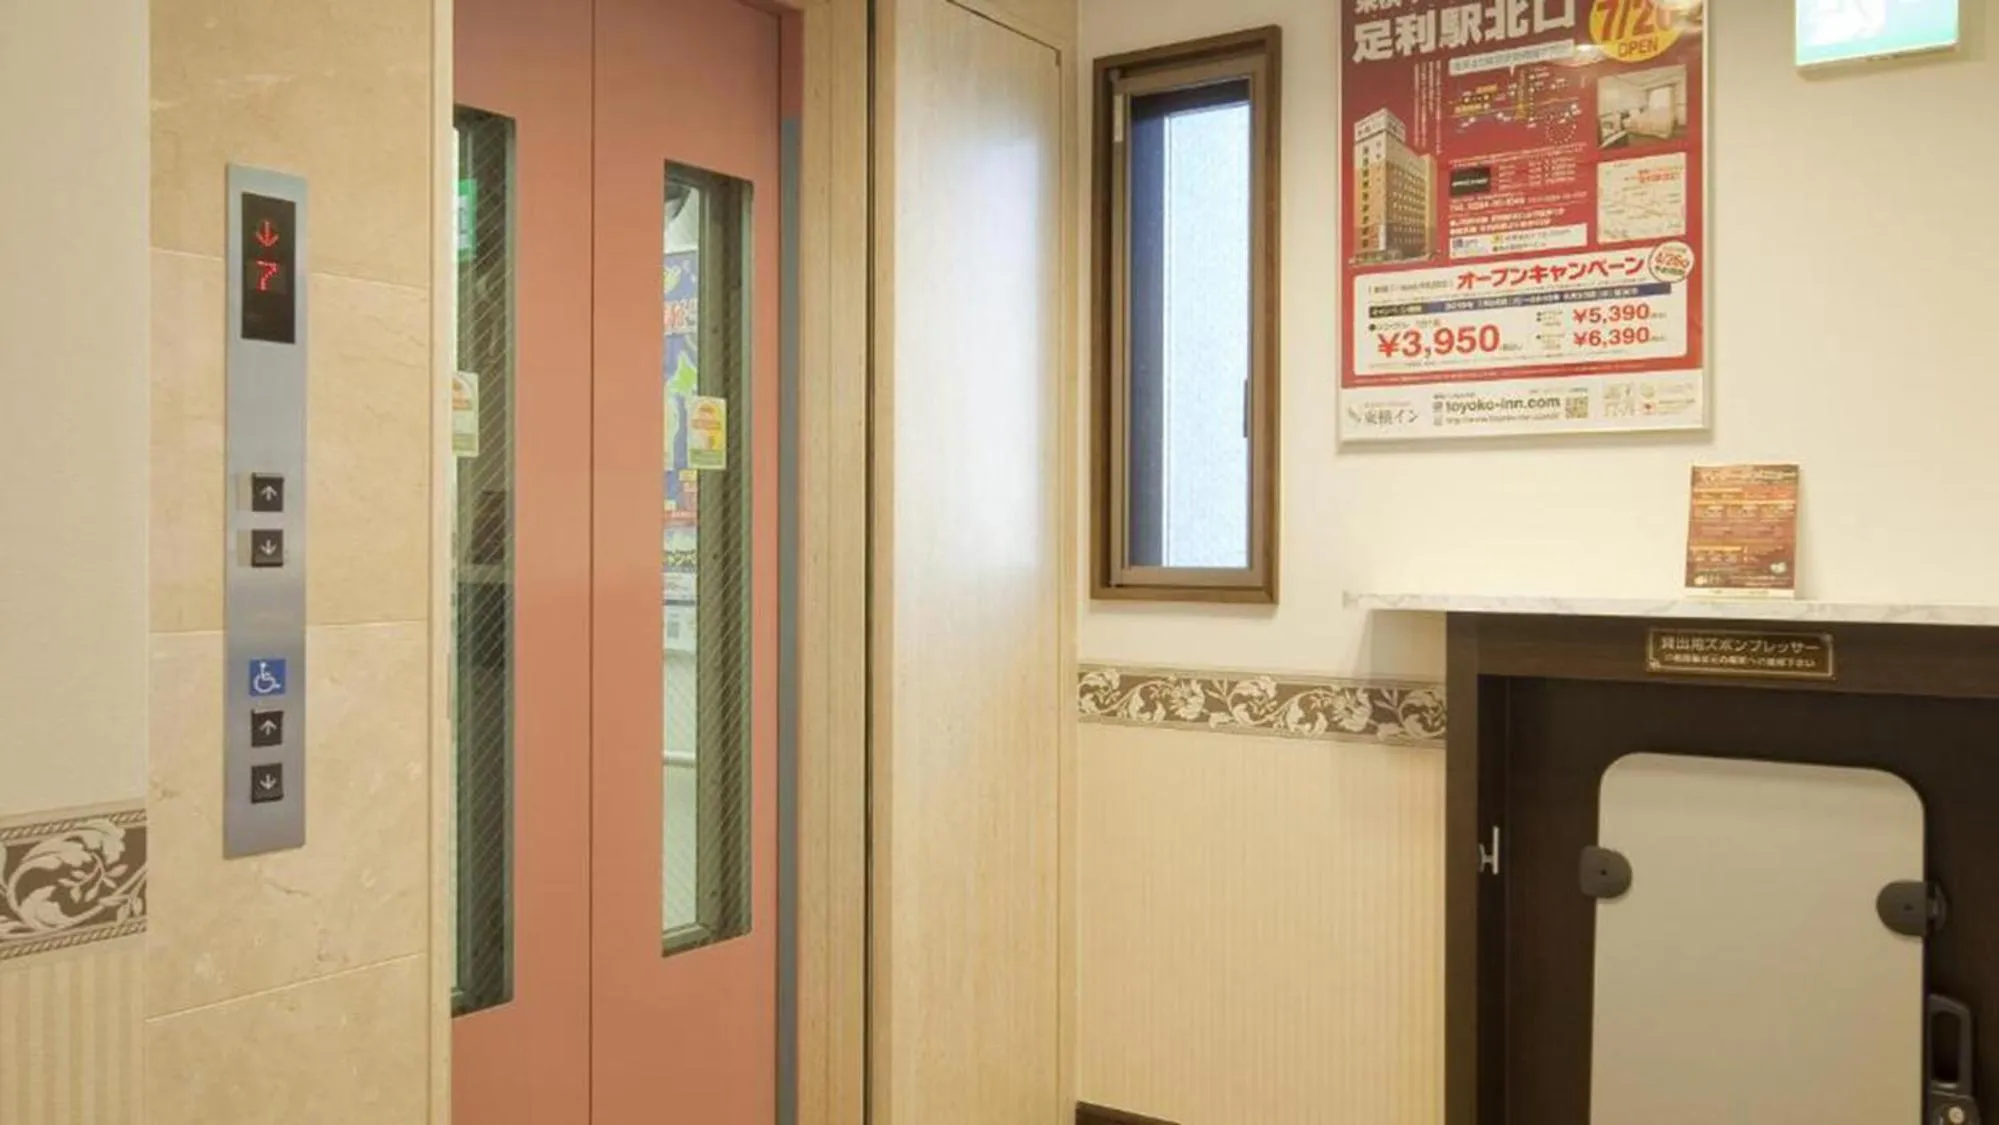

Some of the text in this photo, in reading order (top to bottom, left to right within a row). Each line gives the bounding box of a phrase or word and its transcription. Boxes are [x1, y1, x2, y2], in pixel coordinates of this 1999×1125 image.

[1352, 0, 1576, 63] 足利駅北口
[1618, 36, 1658, 57] OPEN
[256, 259, 280, 292] 7
[1457, 255, 1645, 291] オープンキャンペーン
[1573, 303, 1650, 324] ¥5,390
[1377, 324, 1500, 359] ¥3,950
[1573, 327, 1650, 348] ¥6,390
[1446, 396, 1561, 415] toyoko-inn.com
[1661, 636, 1821, 654] 貸出用ズボンプレッサー
